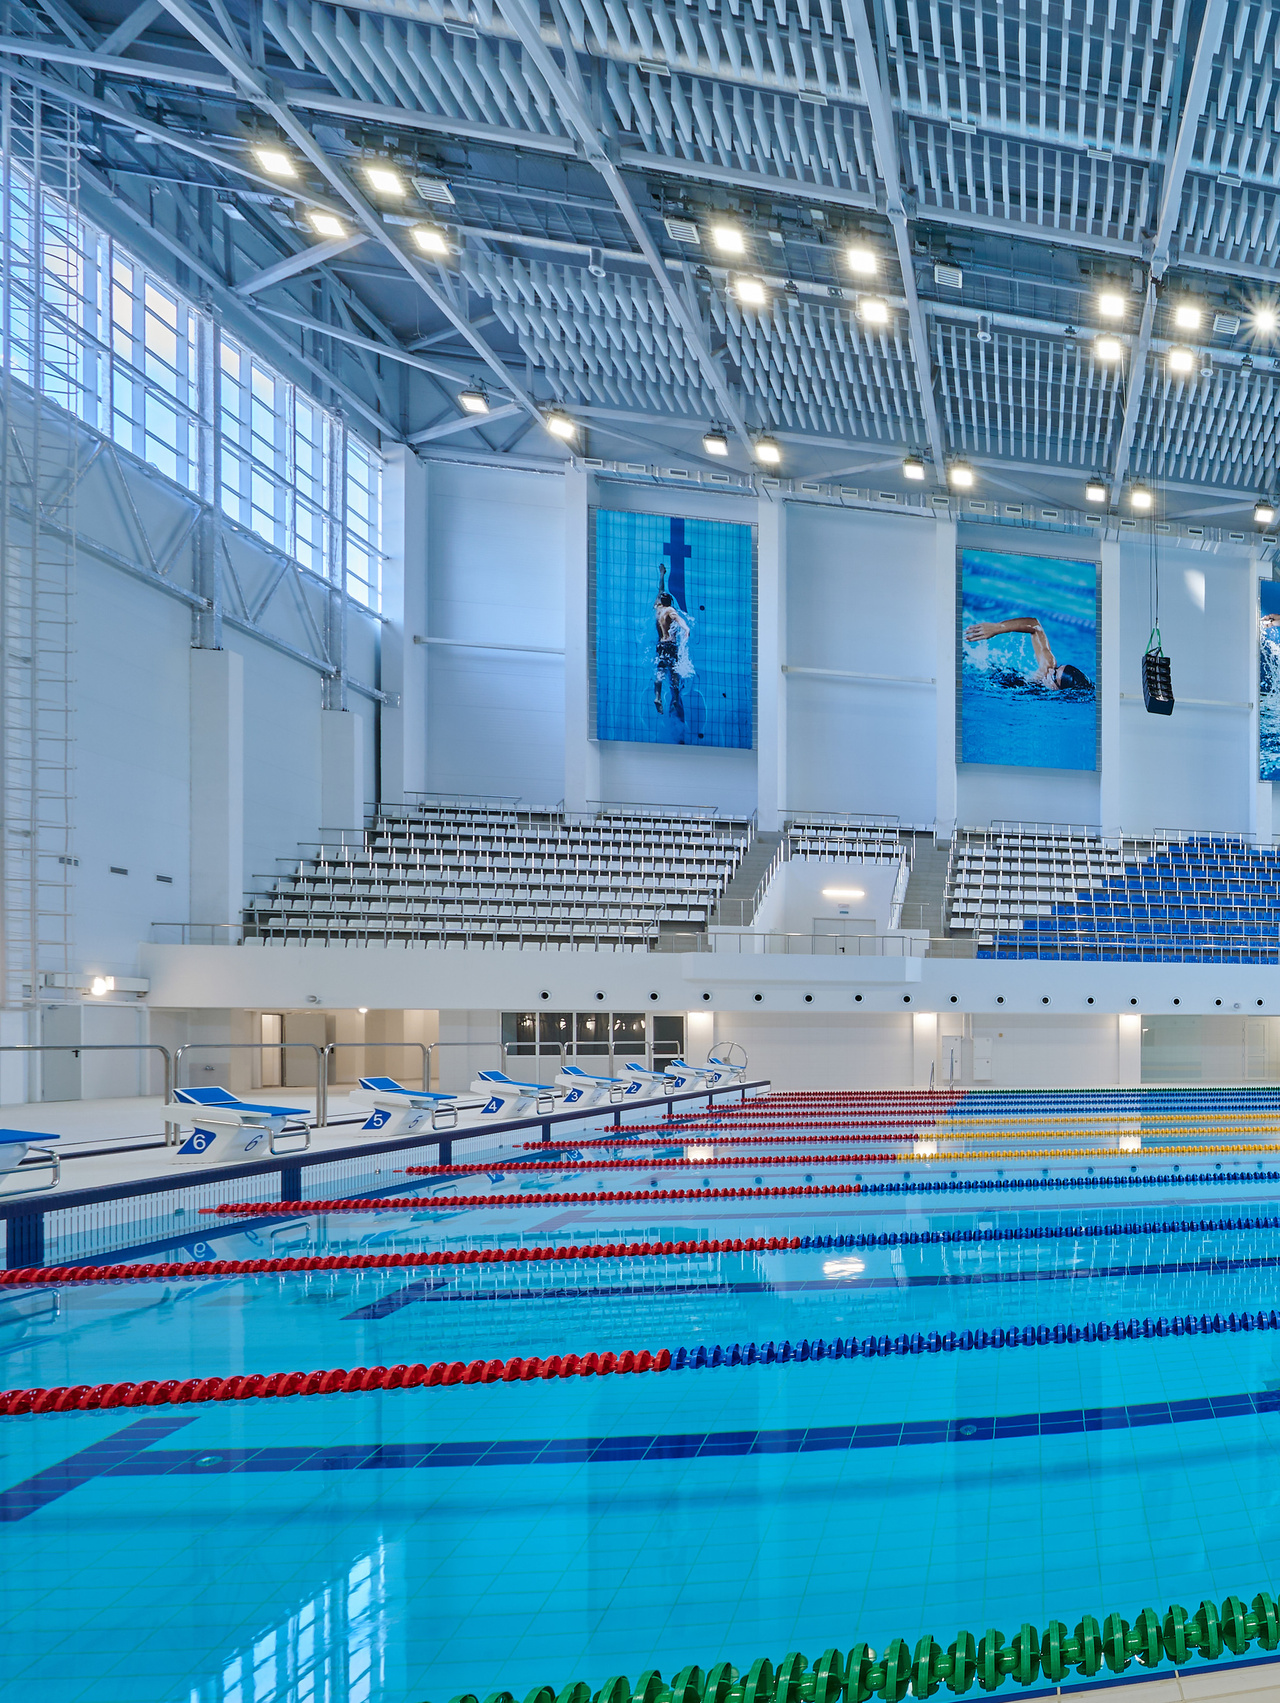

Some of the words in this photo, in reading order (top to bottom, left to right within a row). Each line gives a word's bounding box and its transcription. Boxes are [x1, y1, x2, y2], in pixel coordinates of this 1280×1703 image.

[631, 1084, 637, 1093] 2
[570, 1091, 579, 1101] 3
[488, 1101, 497, 1111] 4
[372, 1113, 384, 1127] 5
[408, 1115, 423, 1129] 5
[193, 1134, 206, 1150] 6
[244, 1134, 263, 1152] 6
